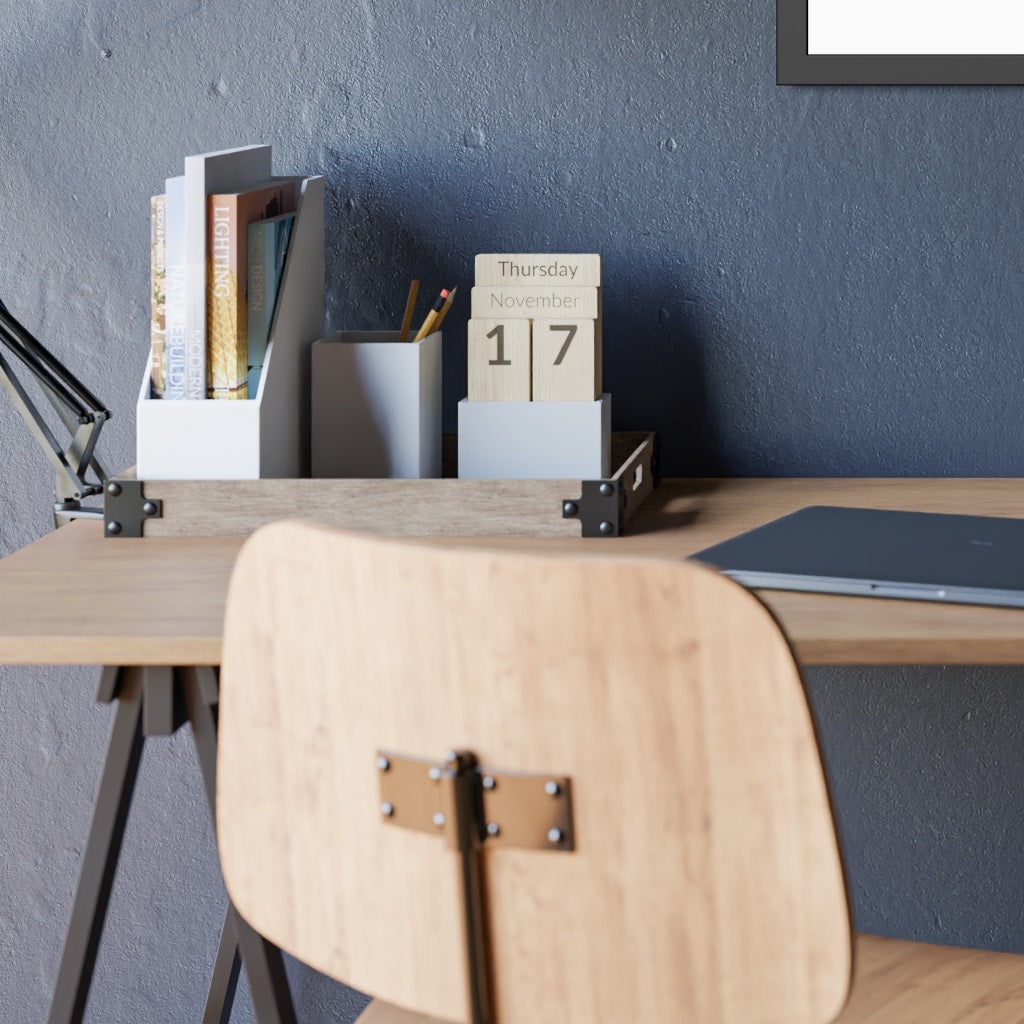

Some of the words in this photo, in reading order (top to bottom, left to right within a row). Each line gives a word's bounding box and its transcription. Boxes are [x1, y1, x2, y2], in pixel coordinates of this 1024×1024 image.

[213, 205, 230, 298] LIGHTING
[497, 260, 579, 280] Thursday
[251, 265, 264, 312] DESIGN
[490, 292, 580, 309] November
[188, 329, 203, 398] MODERN
